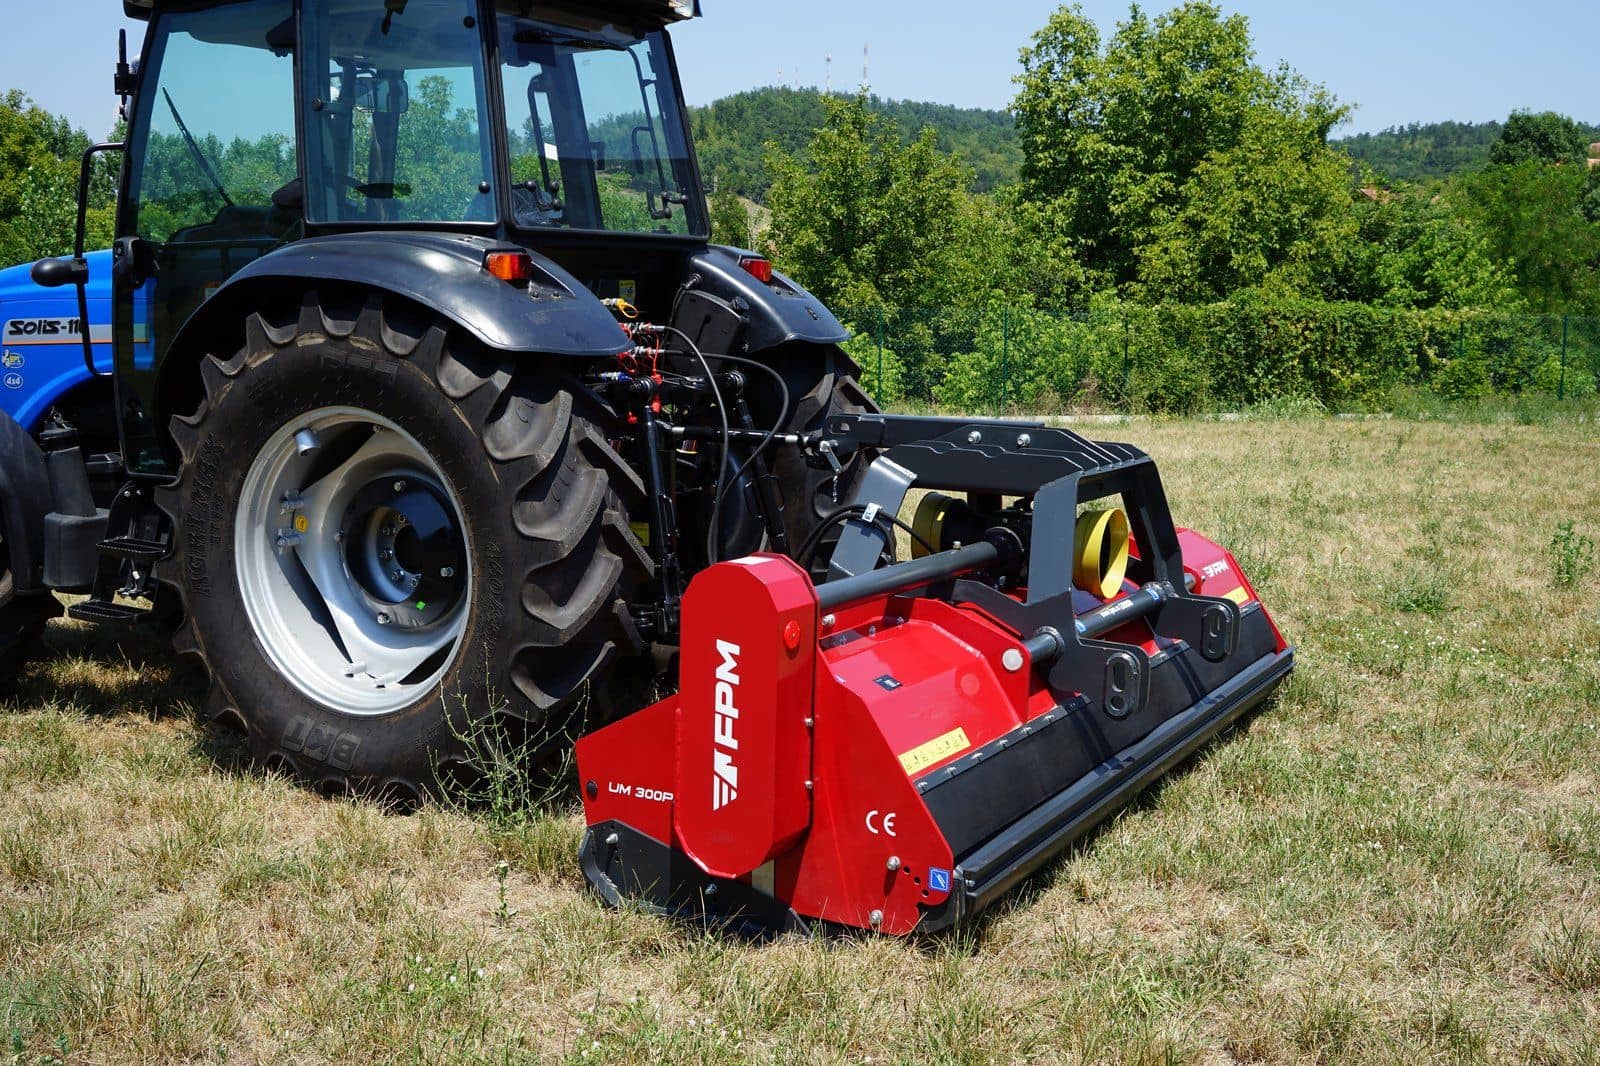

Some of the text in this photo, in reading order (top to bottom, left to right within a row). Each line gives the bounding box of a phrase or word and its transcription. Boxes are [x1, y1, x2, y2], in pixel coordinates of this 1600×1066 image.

[714, 638, 741, 750] FPM
[281, 716, 362, 771] BKT
[608, 781, 675, 802] UM 300P
[865, 809, 897, 837] CE
